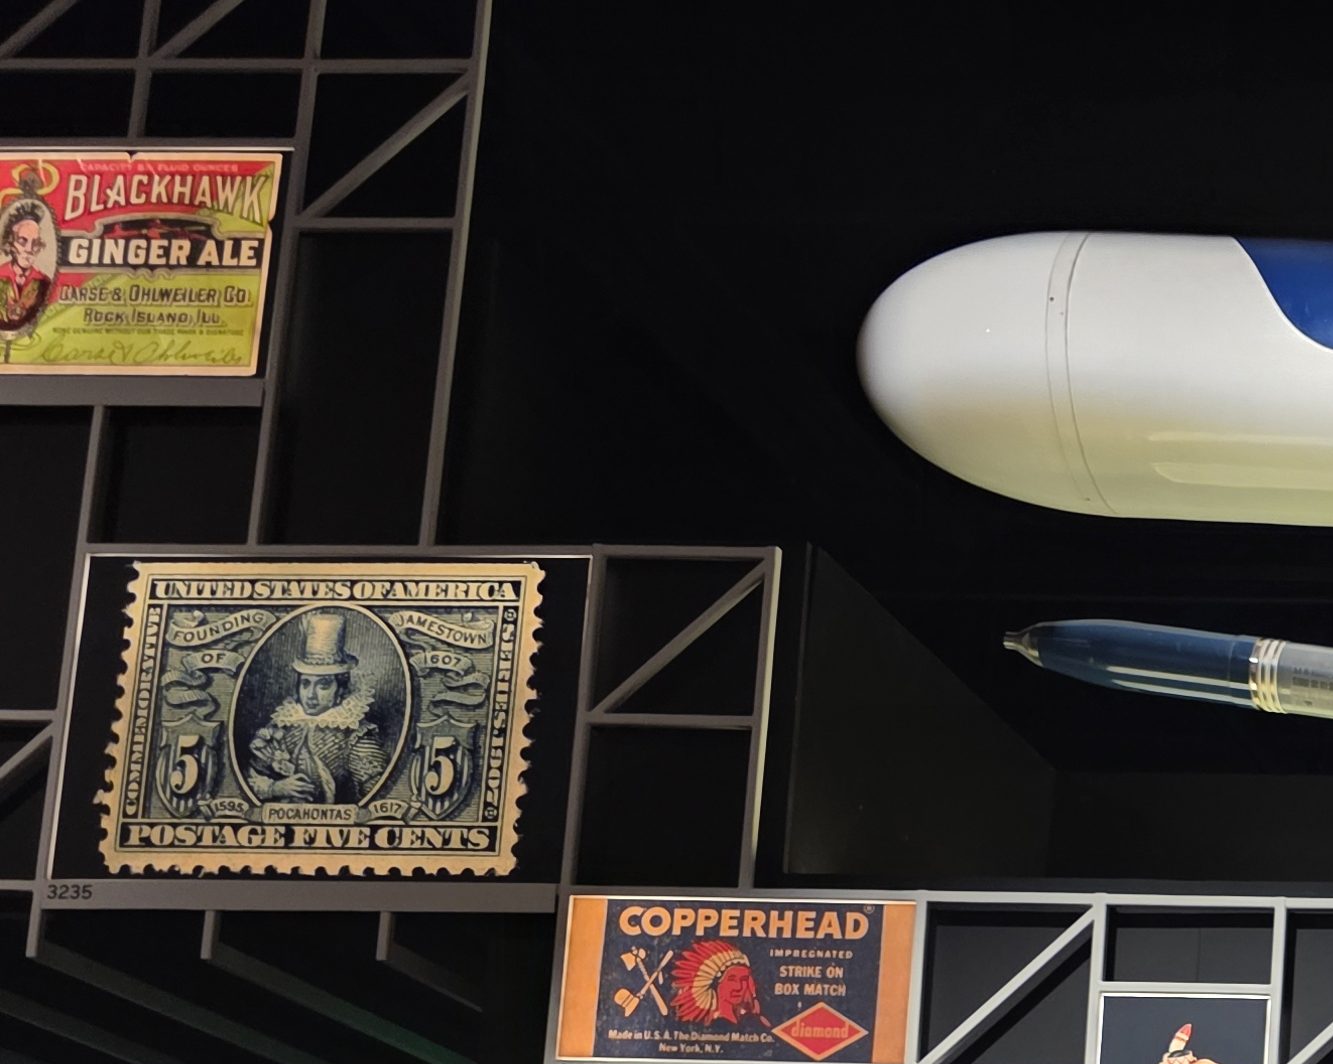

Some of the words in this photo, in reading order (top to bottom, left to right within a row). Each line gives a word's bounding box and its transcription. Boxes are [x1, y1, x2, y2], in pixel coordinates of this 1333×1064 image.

[64, 173, 267, 226] BLACKHAWK
[68, 238, 191, 265] GINGER
[197, 239, 260, 266] ALE
[59, 284, 108, 302] CARSE
[111, 287, 123, 302] &
[129, 284, 218, 303] OHLWEILER
[83, 307, 125, 324] ROCK
[154, 580, 252, 600] UNITED
[254, 581, 351, 601] STATES
[353, 582, 391, 601] OF
[391, 582, 519, 601] AMERICA
[173, 611, 265, 642] FOUNDING
[397, 613, 488, 645] JAMESTOWN
[201, 652, 227, 665] OF
[424, 653, 462, 667] 1607
[124, 606, 161, 816] COMMEMORATIVE
[170, 735, 199, 795] 5
[425, 736, 456, 796] 5
[215, 800, 244, 814] 1595
[268, 806, 353, 821] POCAHONTAS
[373, 802, 403, 815] 1617
[124, 825, 286, 847] POSTAGE
[289, 826, 371, 849] FIVE
[374, 827, 490, 849] CENTS
[47, 884, 93, 900] 3235
[618, 905, 870, 941] COPPERHEAD
[780, 965, 821, 979] STRIKE
[826, 966, 844, 979] ON
[774, 982, 799, 996] BOX
[803, 983, 846, 997] MATCH
[608, 1029, 633, 1041] Made
[634, 1030, 643, 1041] in
[674, 1031, 690, 1042] The
[691, 1031, 730, 1043] Diamond
[731, 1031, 759, 1043] Match
[760, 1032, 776, 1044] Co.
[791, 1022, 849, 1039] diamond
[659, 1042, 677, 1054] New
